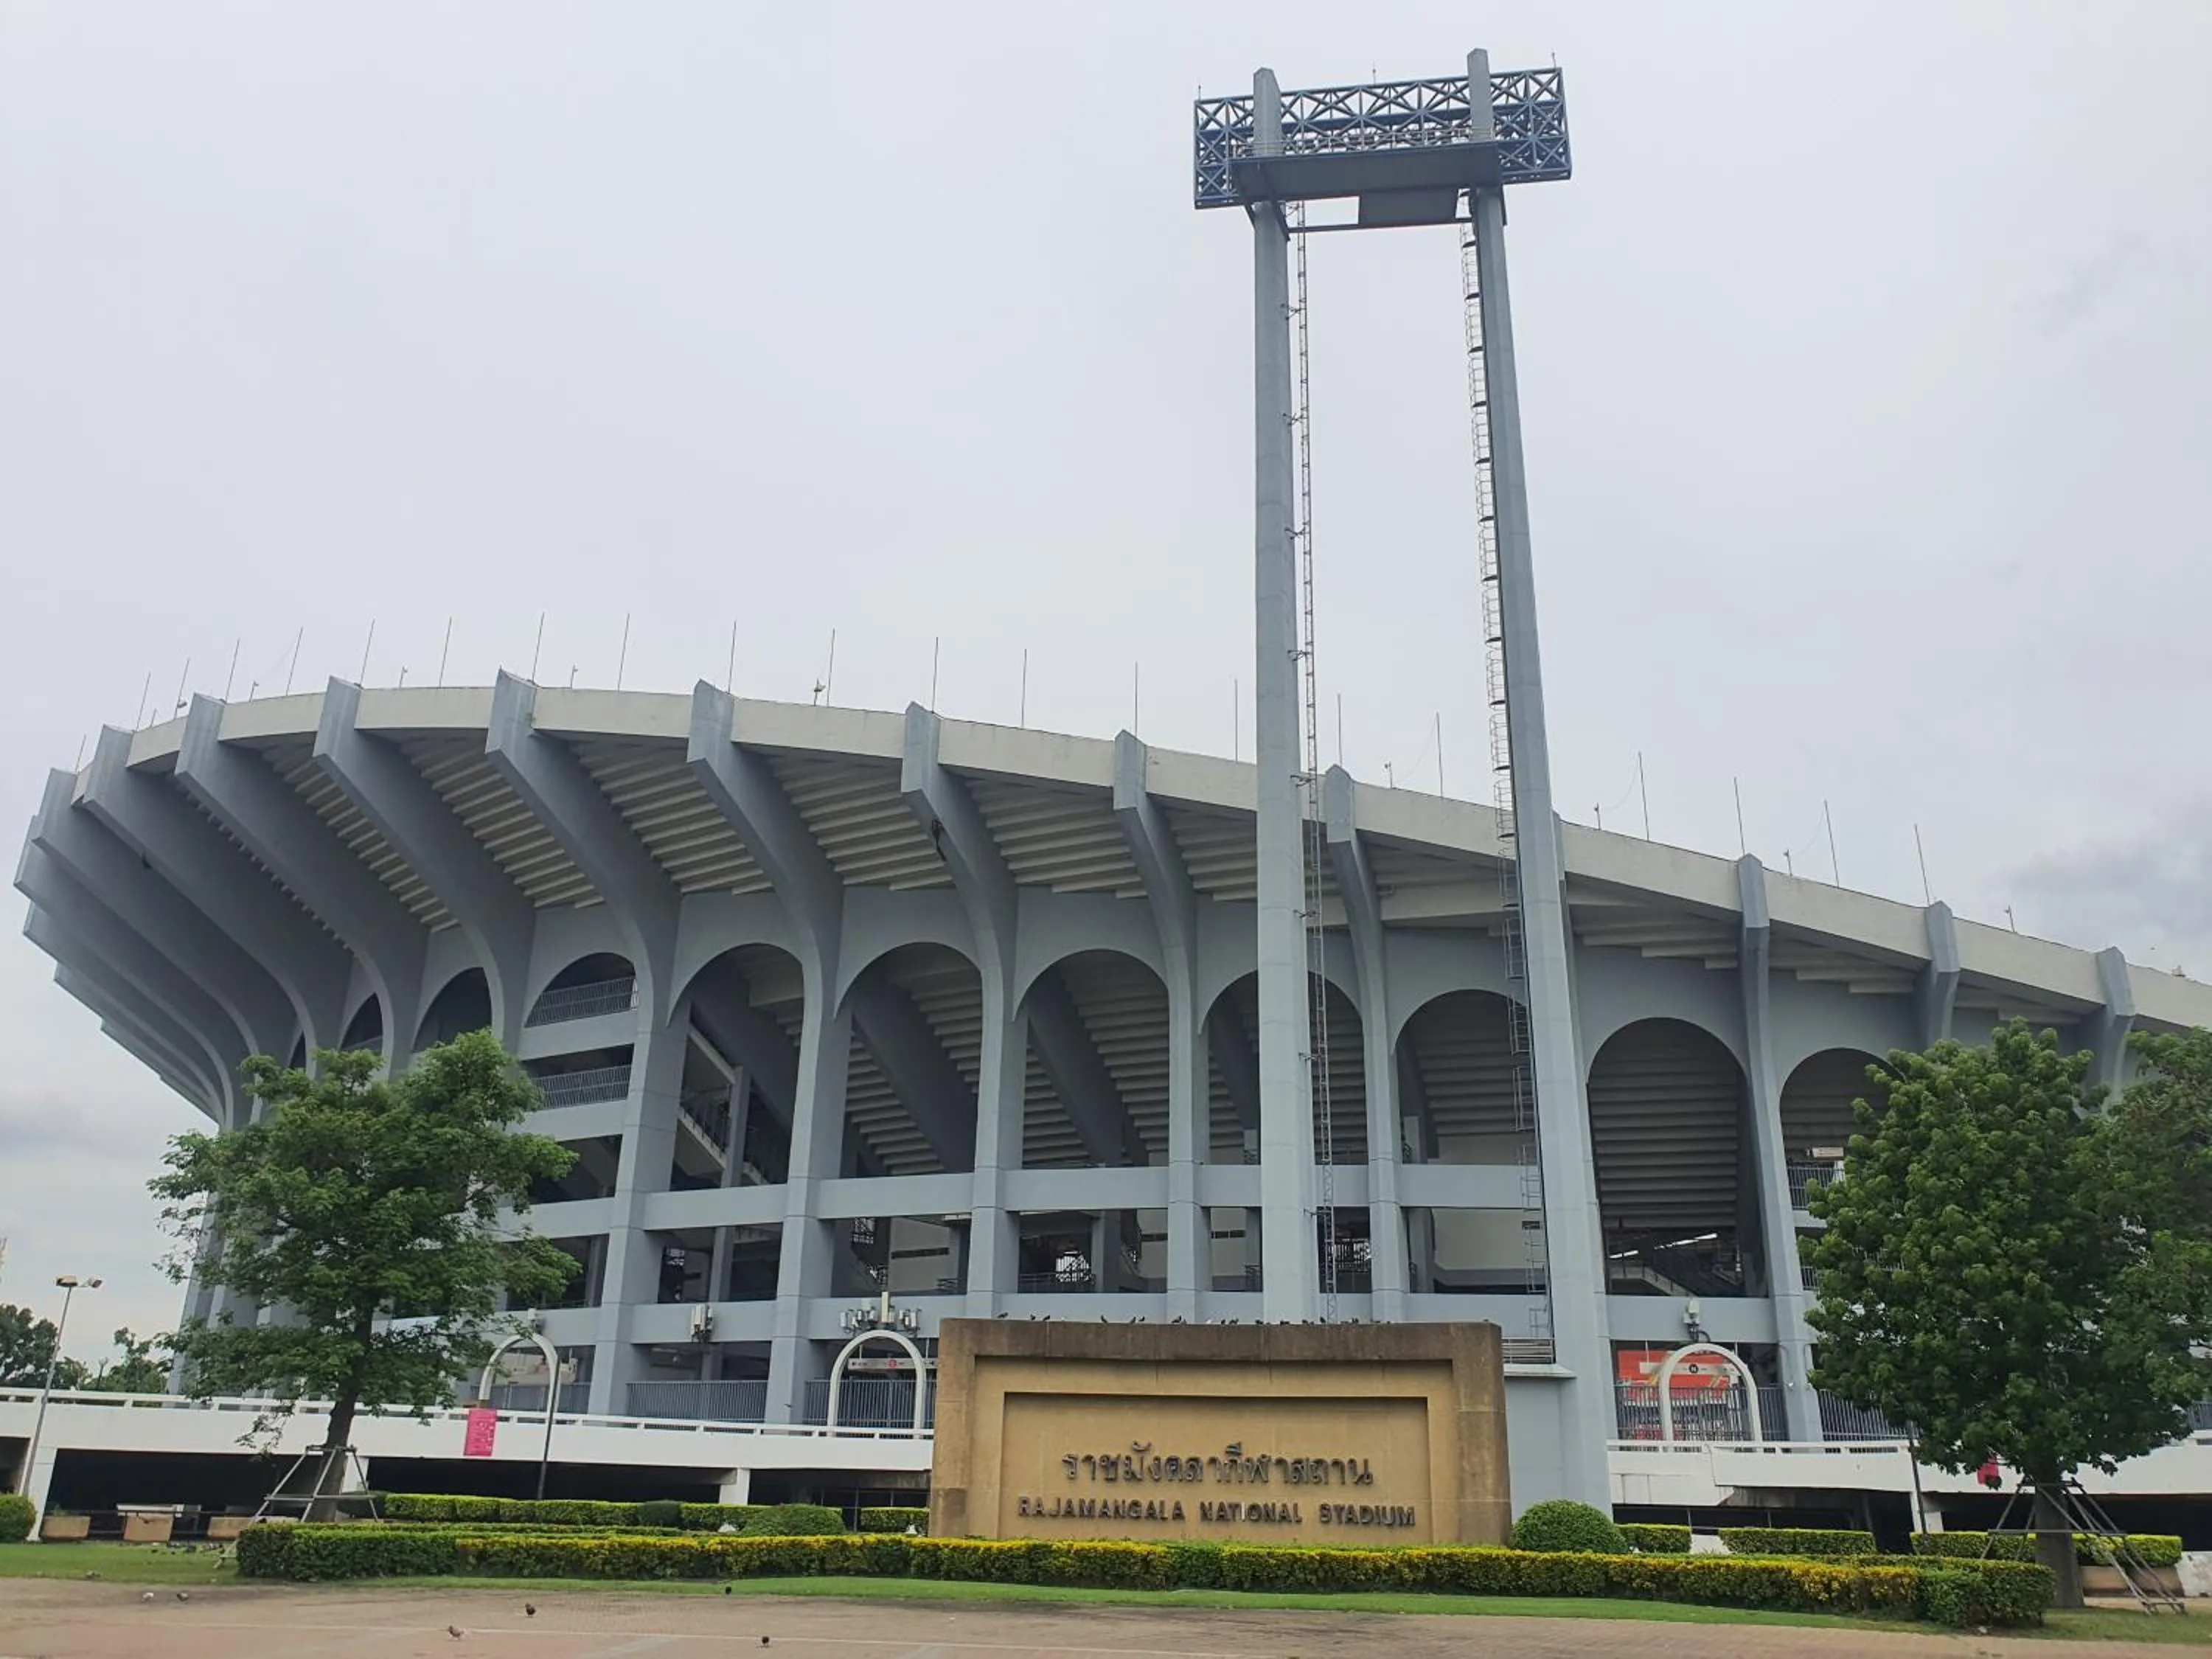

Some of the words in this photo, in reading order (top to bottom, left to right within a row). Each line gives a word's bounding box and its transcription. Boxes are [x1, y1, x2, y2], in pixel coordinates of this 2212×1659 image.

[1062, 1441, 1374, 1484] ราชมังคลากีฬาสถาน
[1018, 1495, 1186, 1520] RAJAMANGALA
[1200, 1501, 1303, 1523] NATIONAL
[1319, 1503, 1416, 1526] STADIUM
